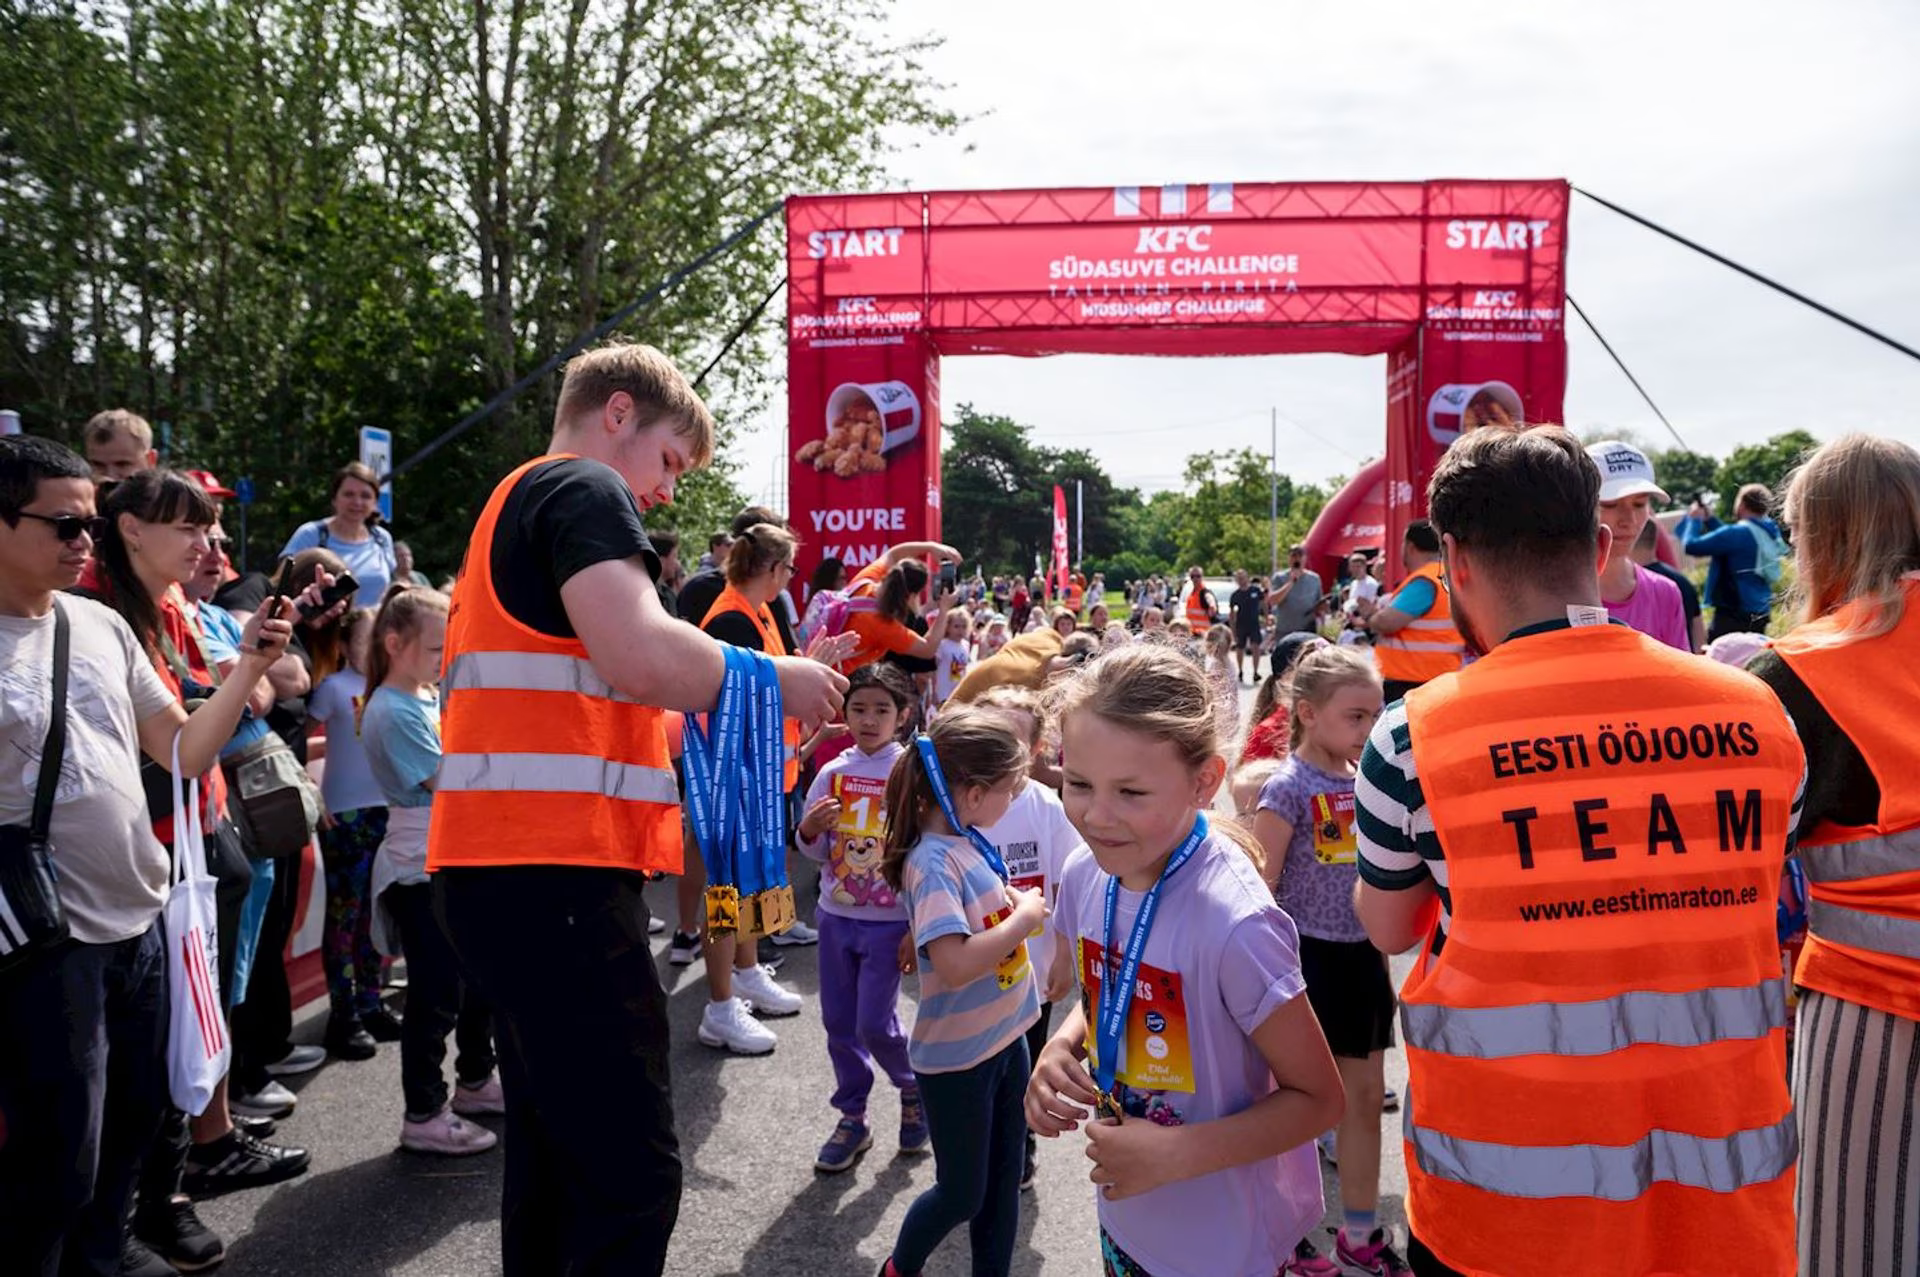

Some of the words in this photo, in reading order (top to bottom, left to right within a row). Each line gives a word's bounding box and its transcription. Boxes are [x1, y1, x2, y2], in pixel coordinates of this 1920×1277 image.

[808, 228, 903, 258] START
[1135, 225, 1212, 254] KFC
[1446, 219, 1549, 250] START
[1049, 255, 1165, 279] SÜDASUVE
[1170, 254, 1299, 275] CHALLENGE
[838, 297, 876, 313] KFC
[1081, 301, 1171, 318] MIDSUMMER
[1176, 298, 1266, 315] CHALLENGE
[1474, 290, 1517, 307] KFC
[855, 311, 921, 327] CHALLENGE
[1609, 464, 1633, 472] DRY
[810, 508, 906, 532] YOU'RE
[1488, 734, 1590, 778] EESTI
[1597, 722, 1760, 765] ÖÖJOOKS
[850, 797, 870, 830] 1
[1502, 789, 1762, 869] TEAM
[1520, 886, 1758, 922] www.eestimaraton.ee
